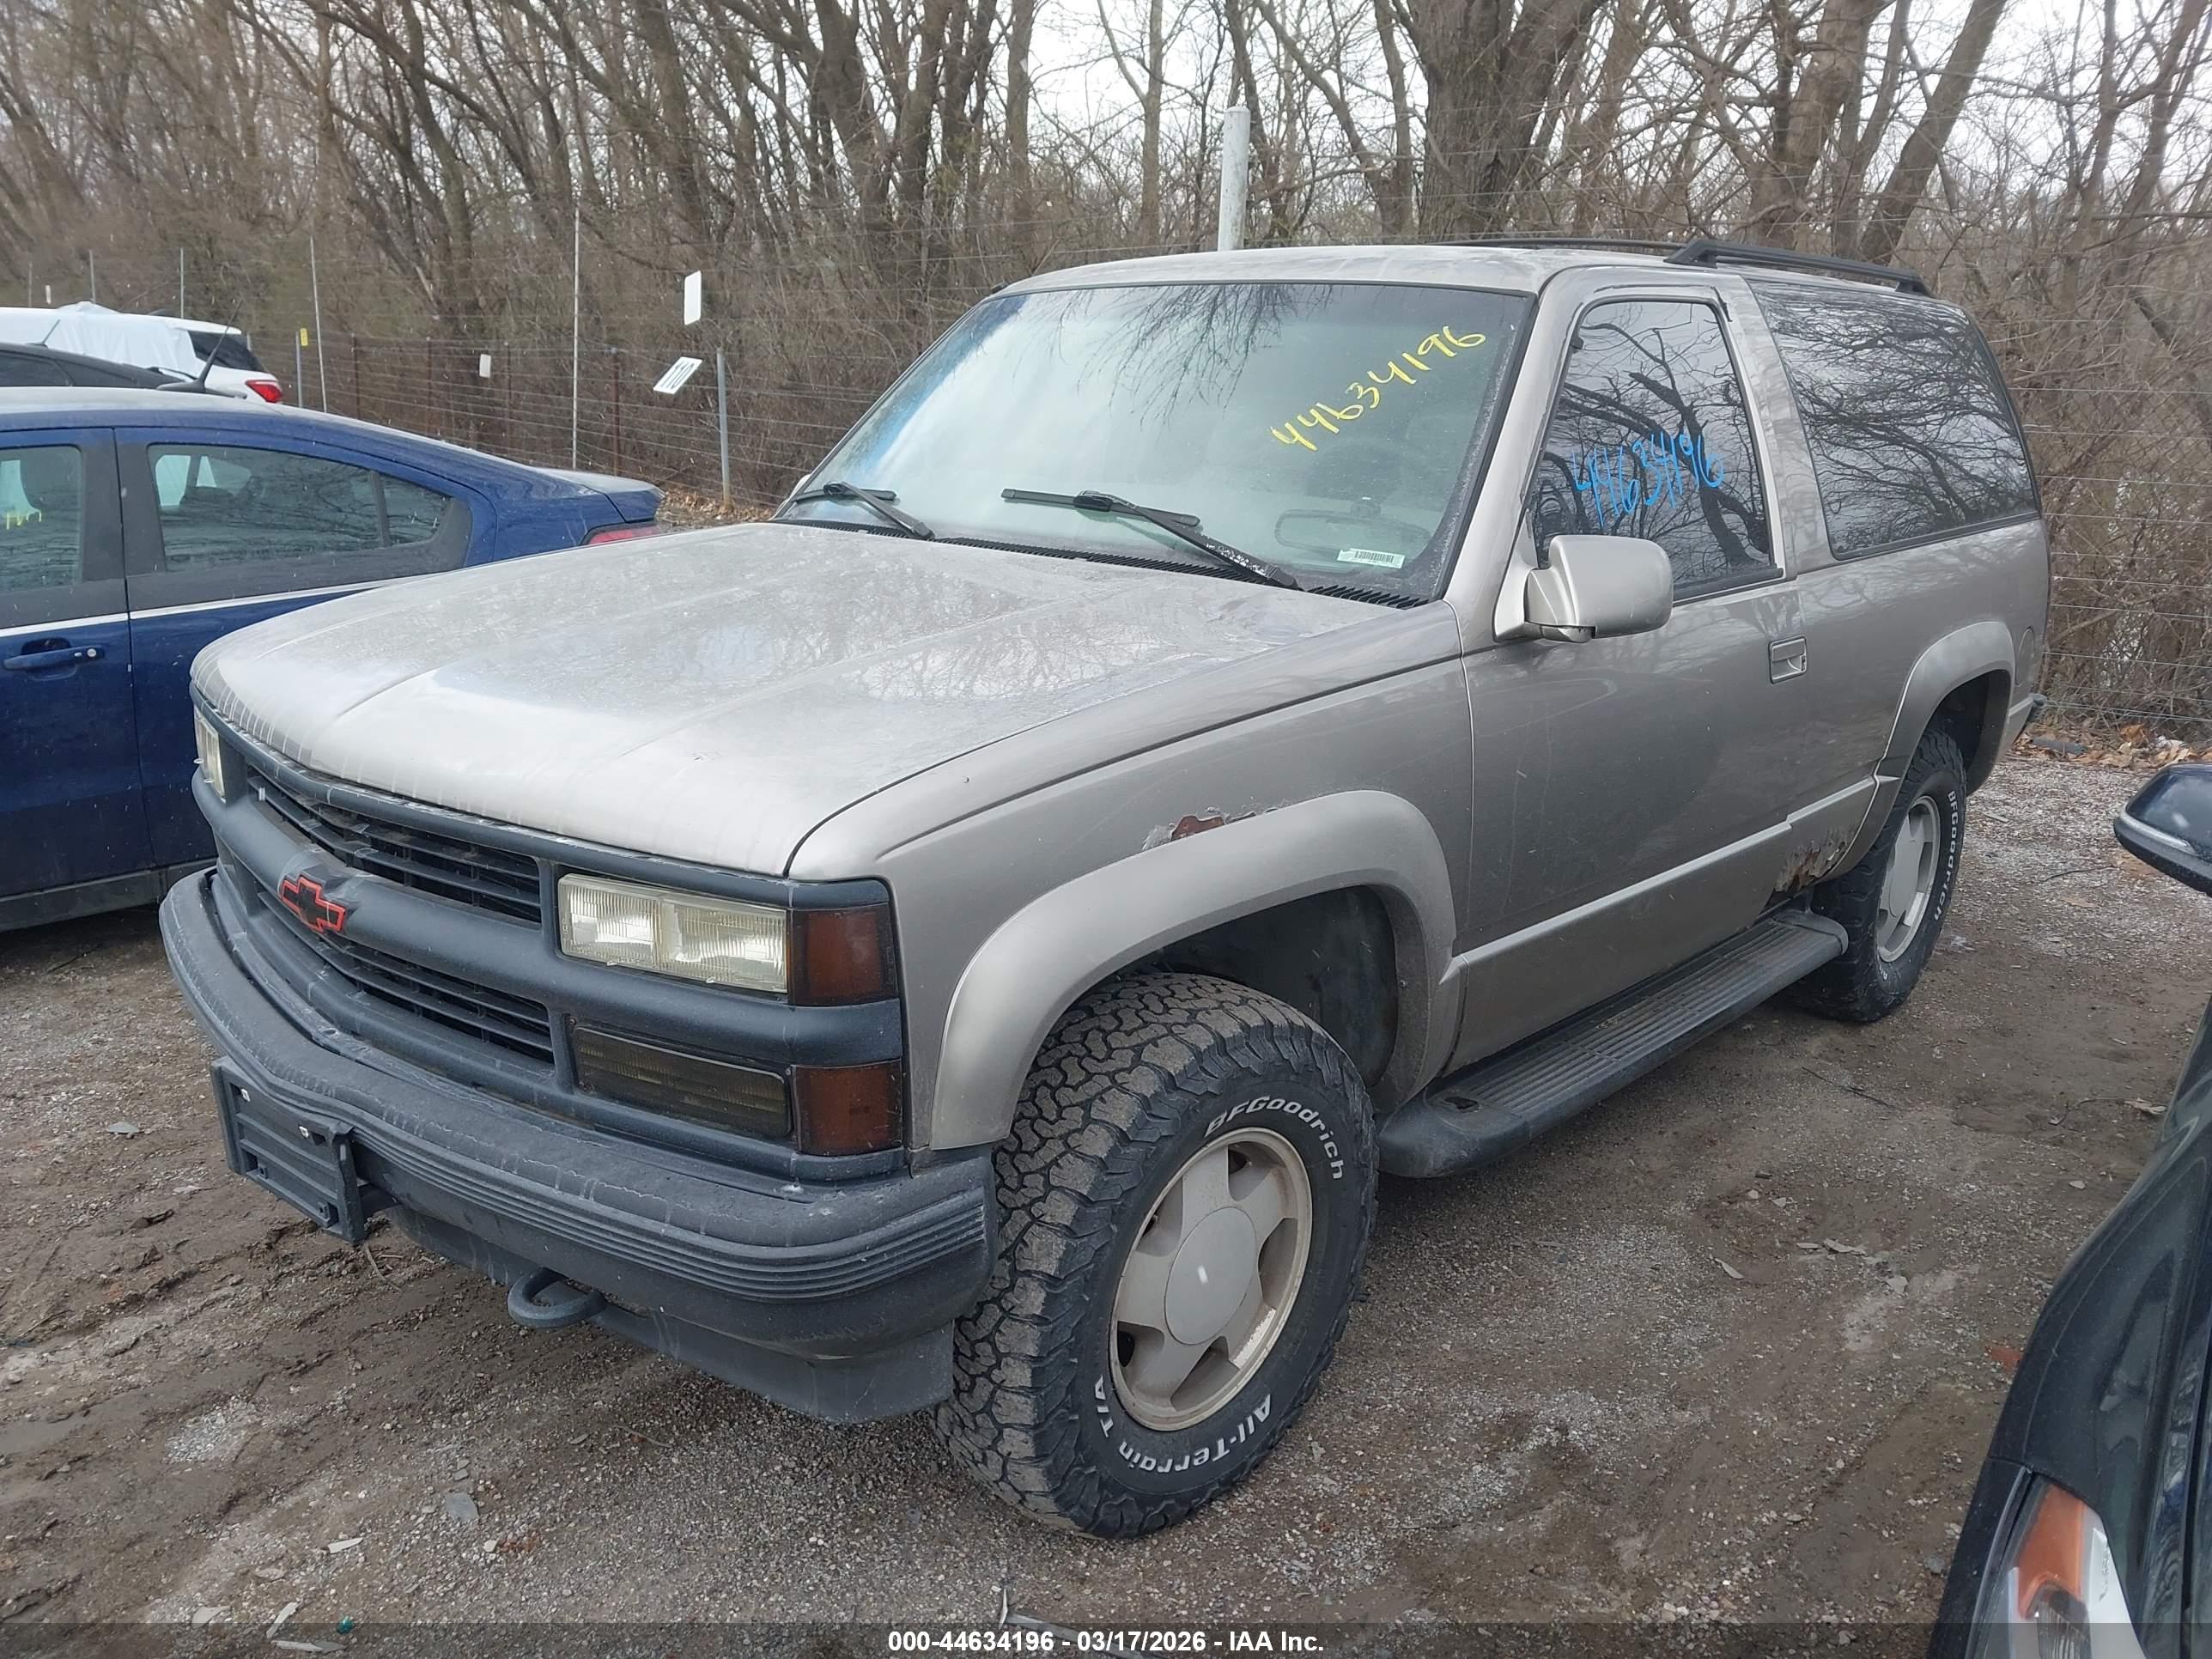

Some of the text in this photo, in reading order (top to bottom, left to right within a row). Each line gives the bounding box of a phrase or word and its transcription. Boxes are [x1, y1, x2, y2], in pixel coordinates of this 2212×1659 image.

[1270, 325, 1486, 451] 44634196
[1572, 431, 1724, 528] 44634196
[1203, 1095, 1345, 1180] BFGoodrich
[1118, 1394, 1272, 1474] All-Terrain
